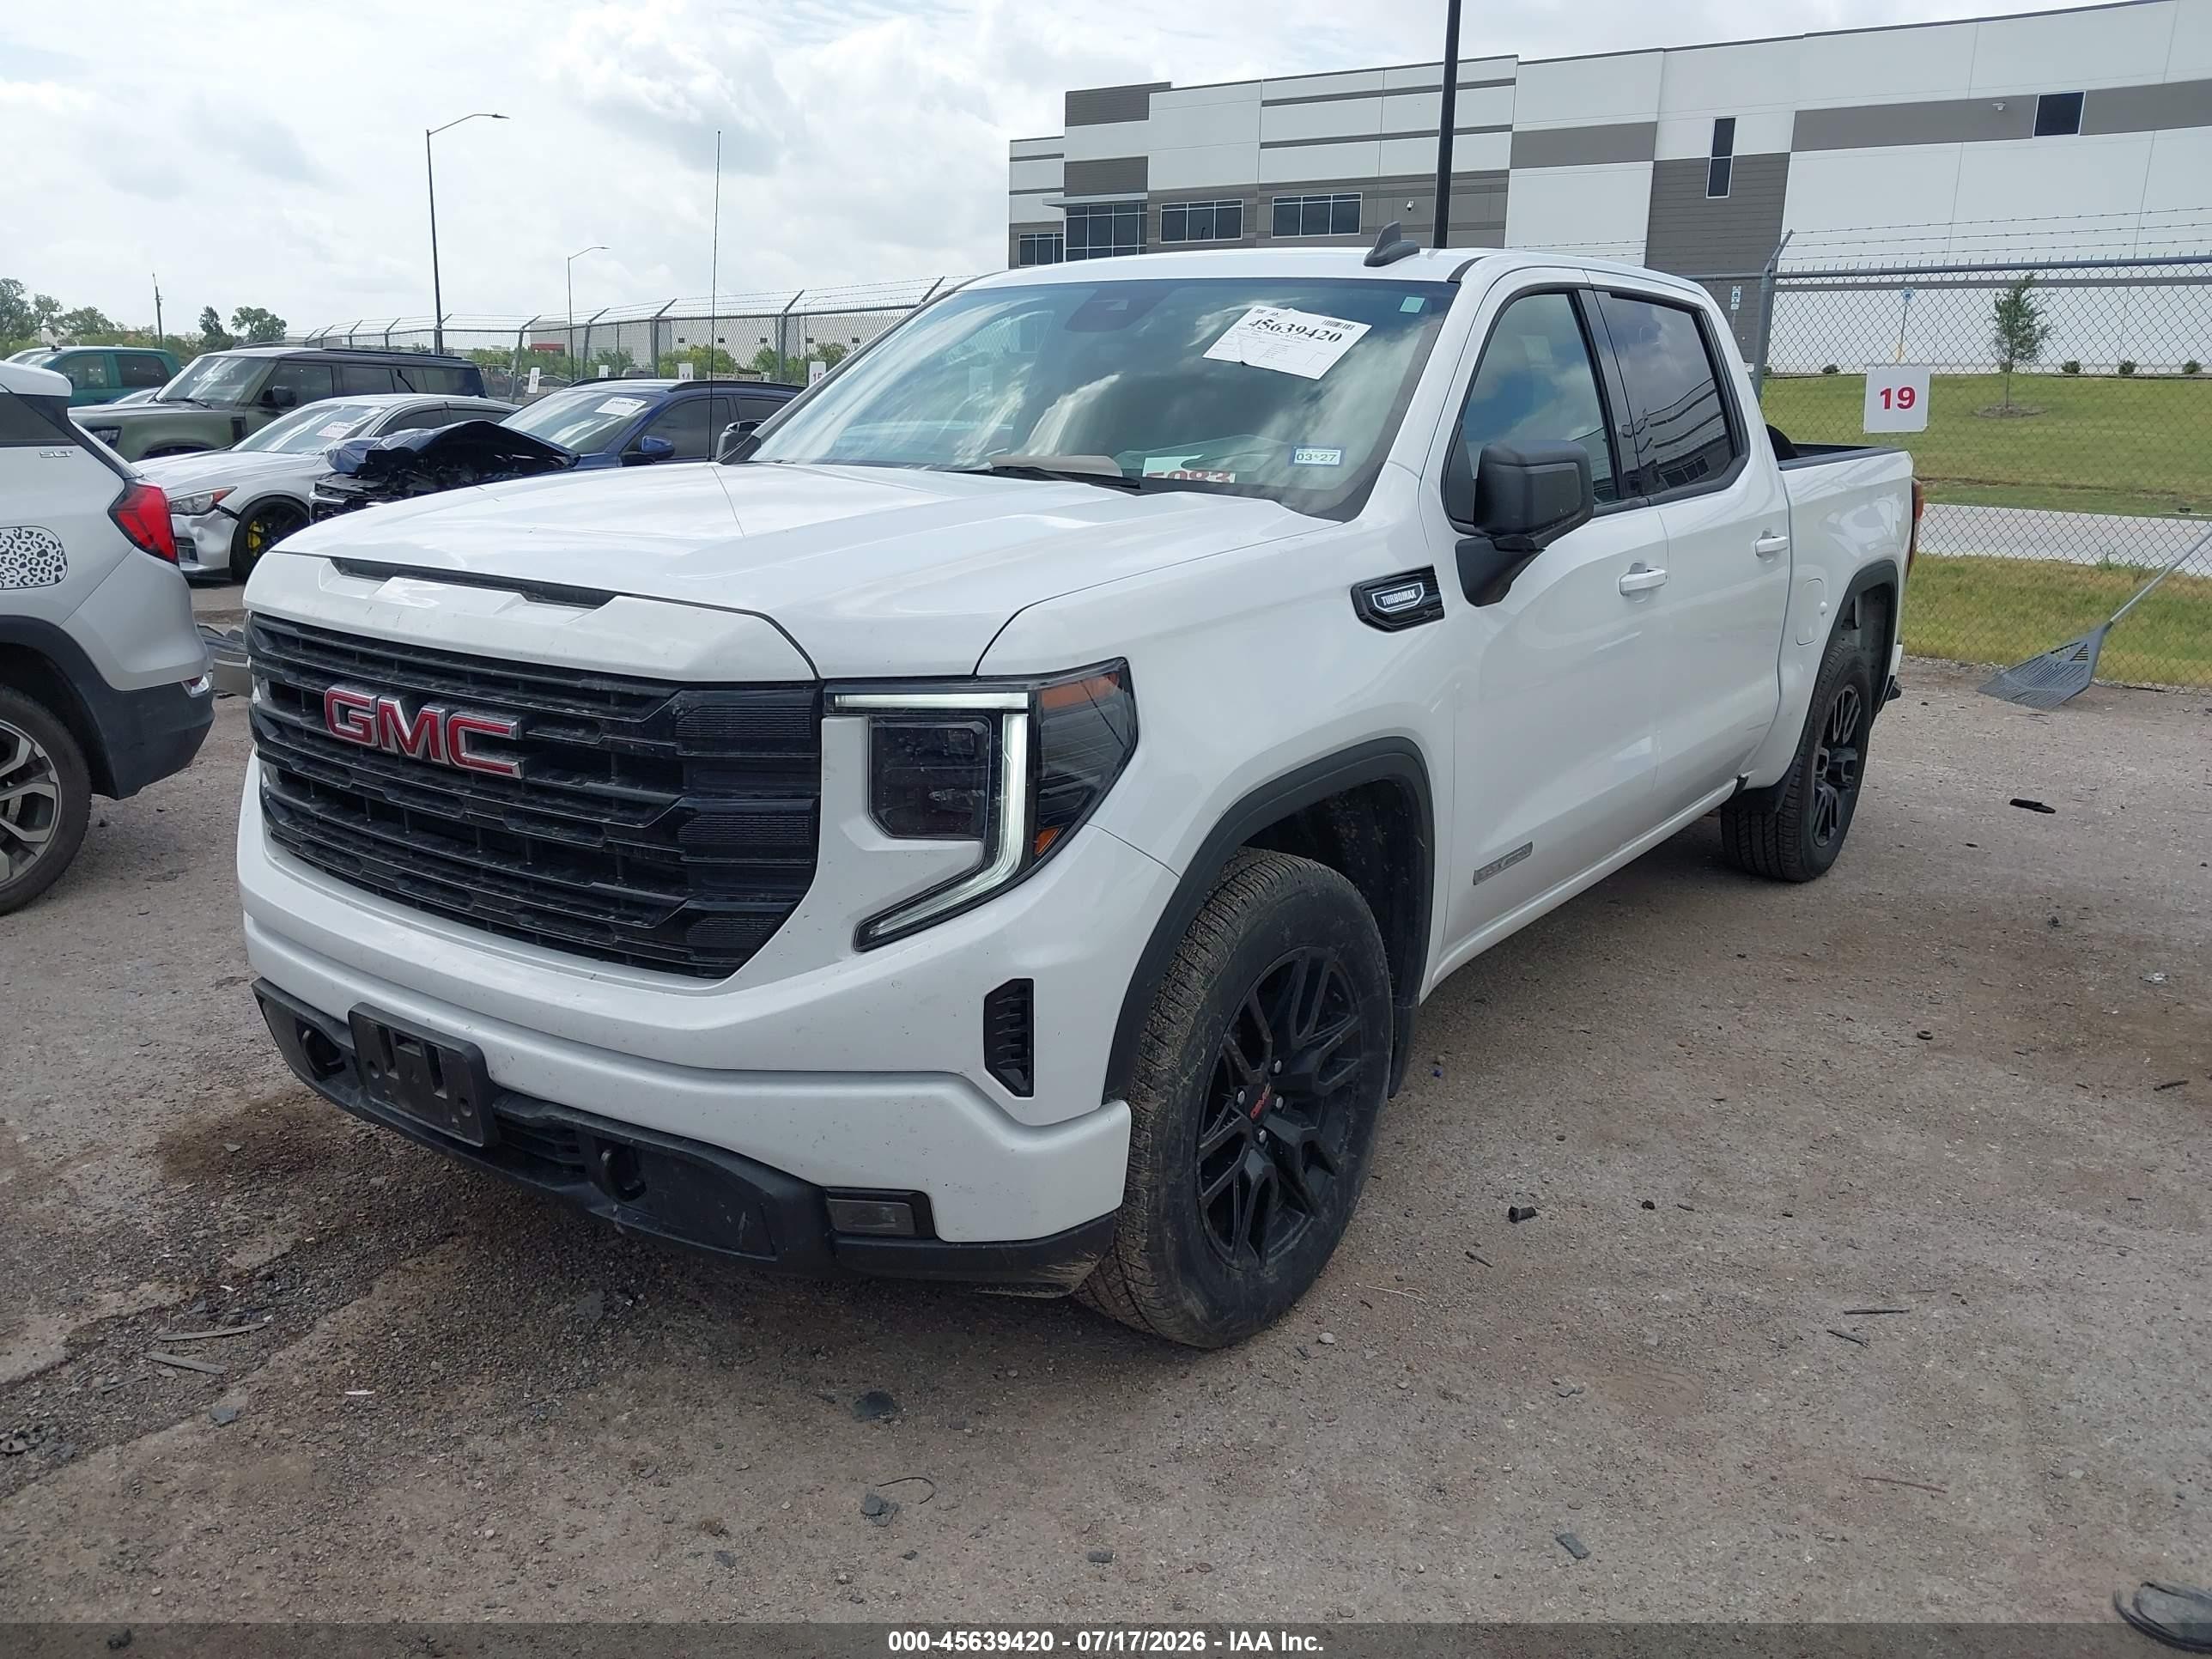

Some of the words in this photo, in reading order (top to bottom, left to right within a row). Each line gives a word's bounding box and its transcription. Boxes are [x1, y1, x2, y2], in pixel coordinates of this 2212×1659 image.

[1248, 319, 1343, 343] 45639420
[1879, 386, 1916, 410] 19
[40, 450, 74, 459] SLT
[1380, 588, 1417, 606] TURBOMAX
[324, 684, 523, 780] GMC
